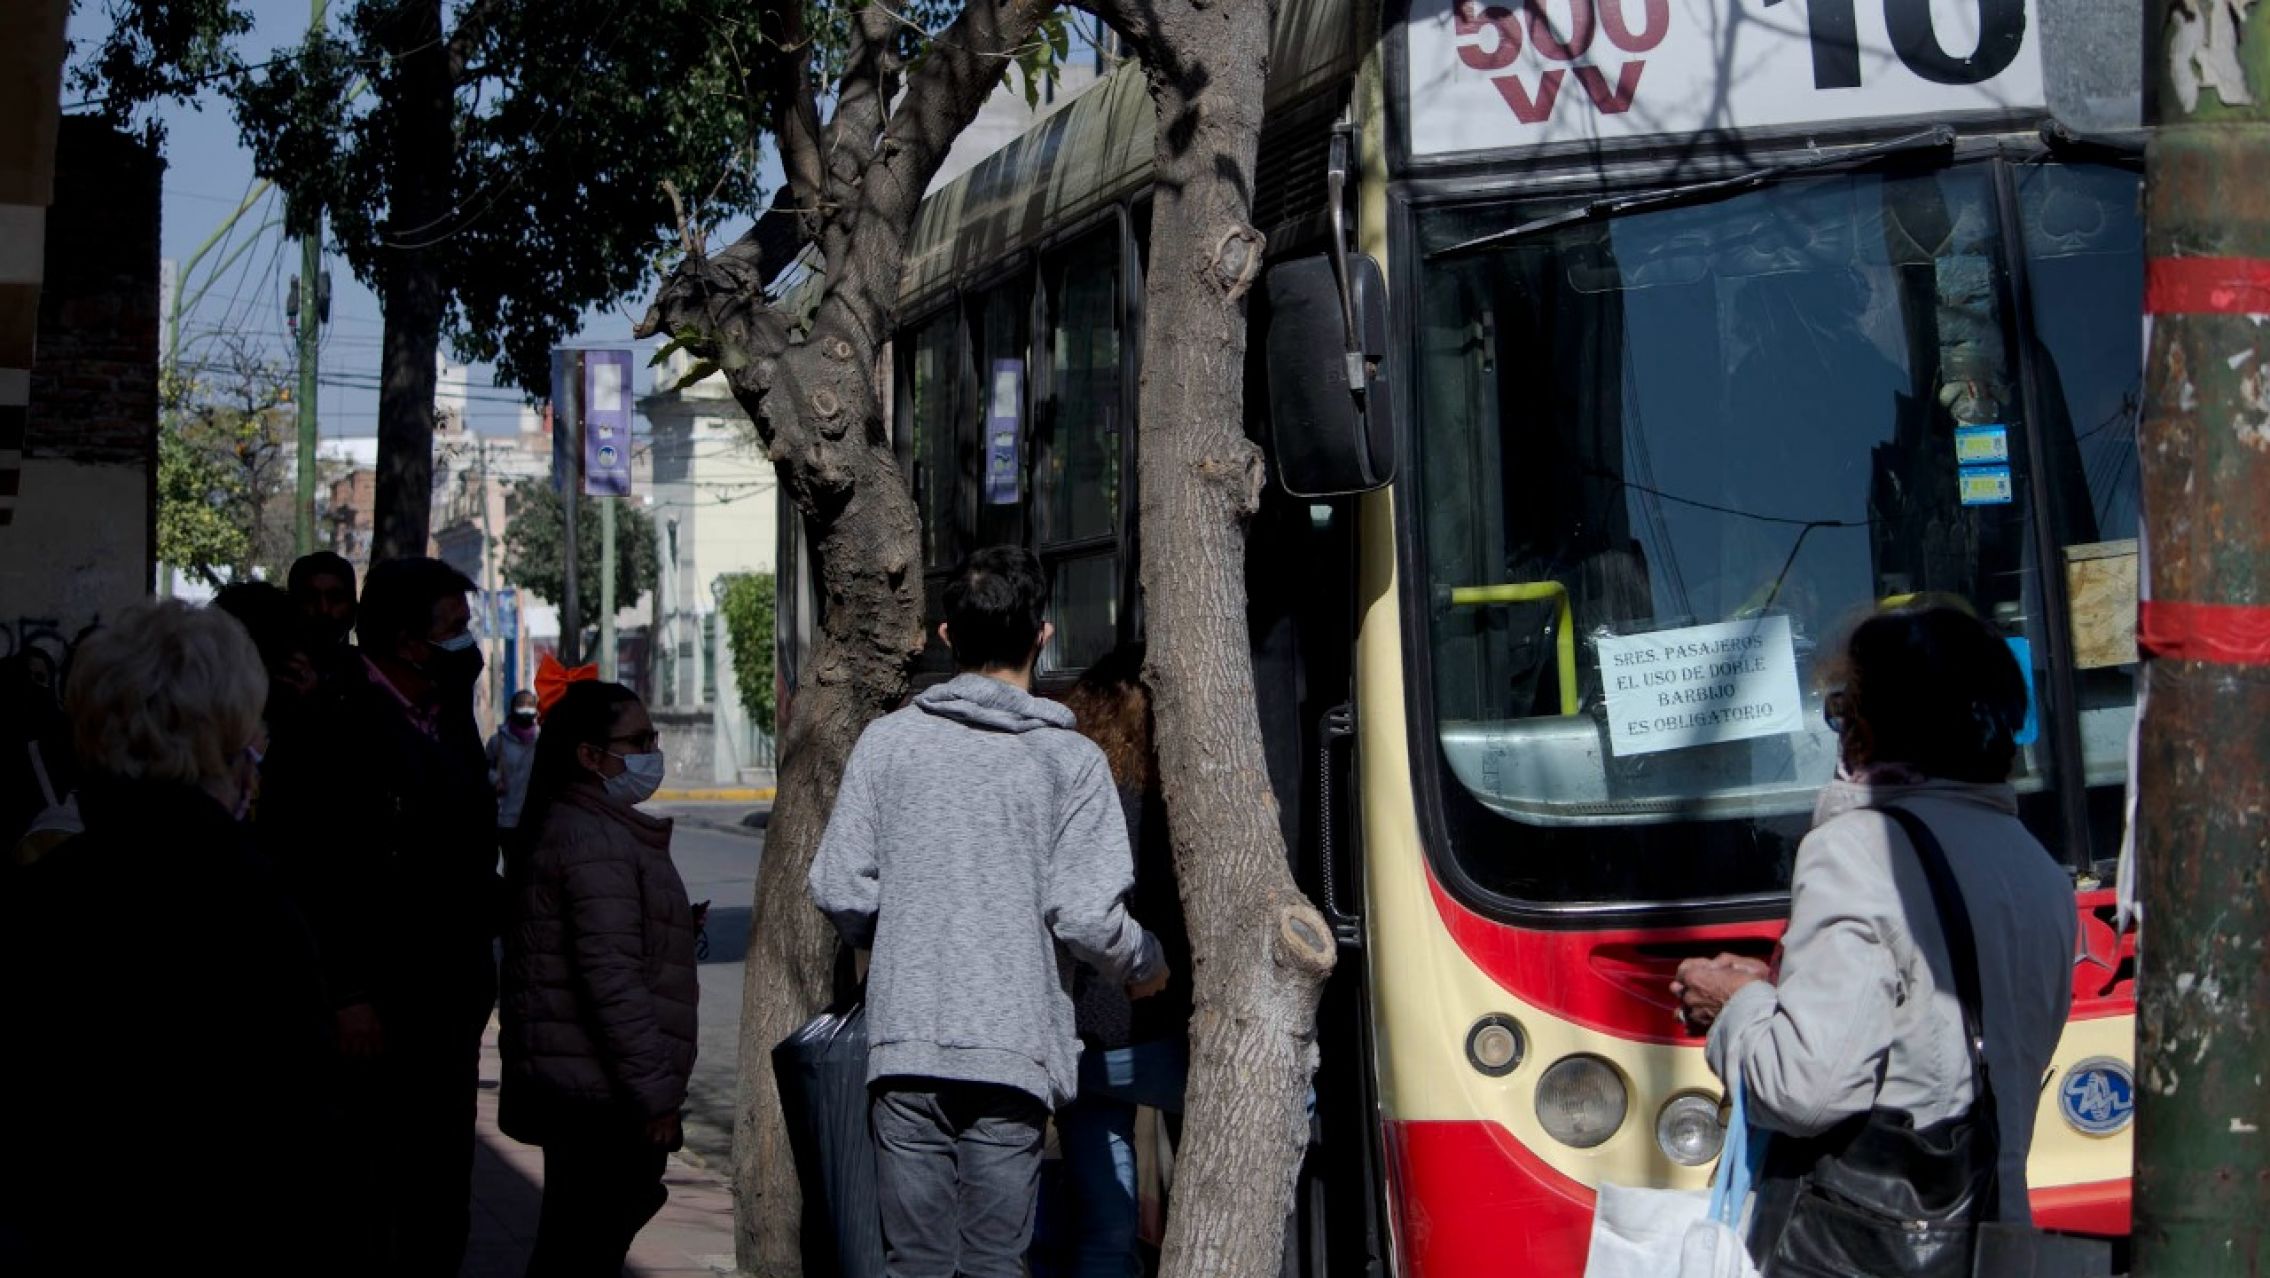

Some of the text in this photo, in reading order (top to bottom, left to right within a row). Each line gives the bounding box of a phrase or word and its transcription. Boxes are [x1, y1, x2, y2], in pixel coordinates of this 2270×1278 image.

[1453, 0, 1670, 71] 500
[1490, 59, 1647, 125] VV
[1613, 635, 1763, 667] SRES. PASAJEROS
[1617, 657, 1766, 691] EL USO DE DOBLE
[1657, 683, 1736, 707] BARBIJO
[1628, 703, 1773, 735] ES OBLIGATORIO
